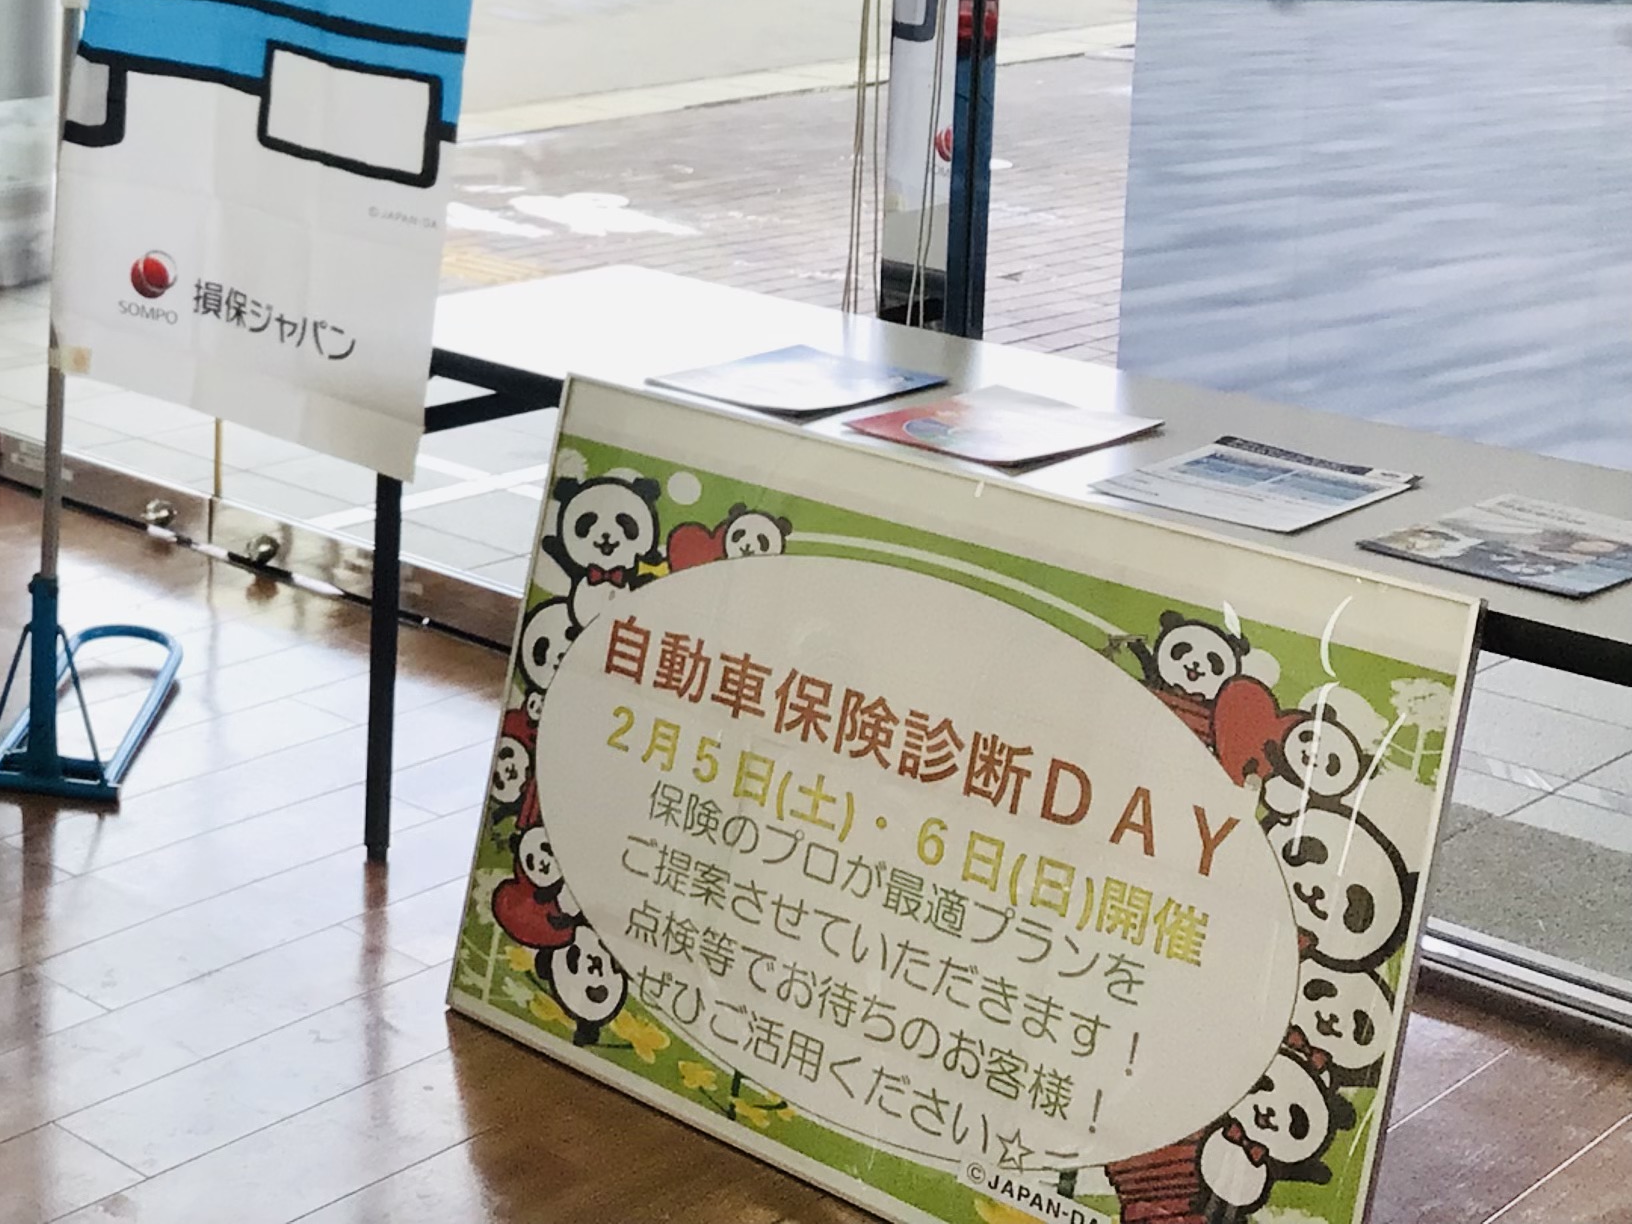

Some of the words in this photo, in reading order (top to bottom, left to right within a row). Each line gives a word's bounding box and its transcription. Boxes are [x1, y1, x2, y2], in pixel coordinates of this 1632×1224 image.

[117, 299, 179, 326] SOMPO
[193, 278, 357, 361] 損保ジャパン
[649, 780, 1145, 1006] 保険のプロが最適プランを
